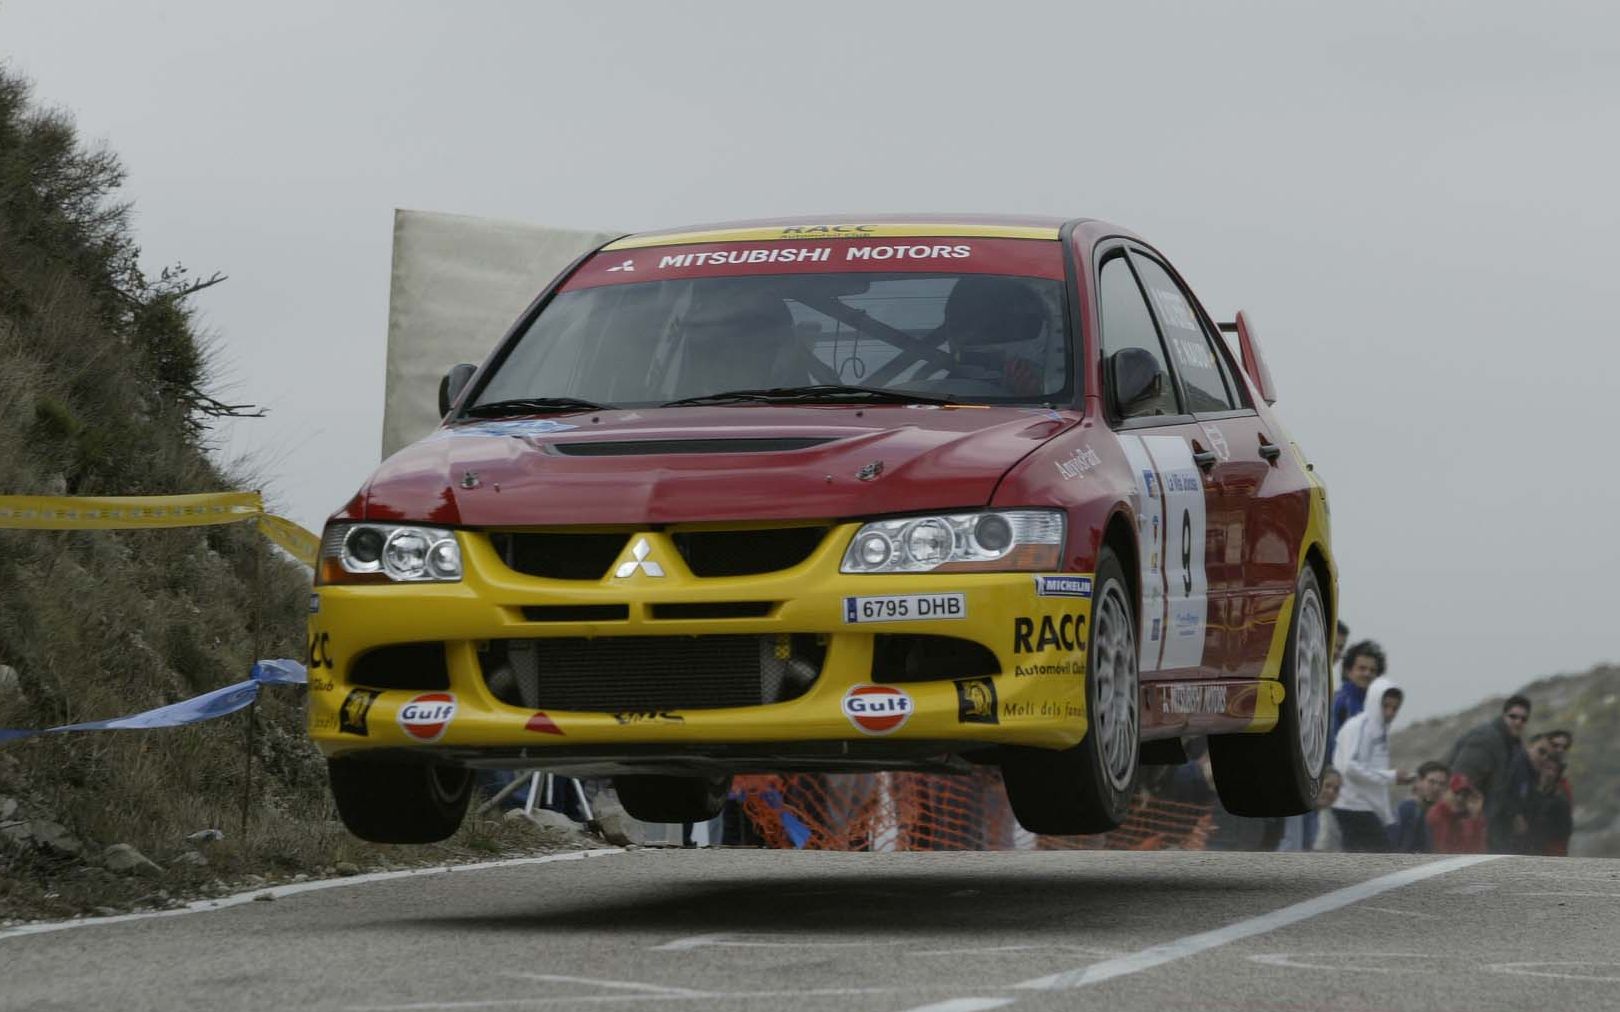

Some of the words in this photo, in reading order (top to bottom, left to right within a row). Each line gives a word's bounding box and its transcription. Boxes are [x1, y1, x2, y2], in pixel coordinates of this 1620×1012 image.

[782, 224, 879, 233] RACC
[658, 247, 830, 269] MITSUBISHI
[846, 244, 971, 260] MOTORS
[1181, 508, 1192, 598] 9
[1046, 580, 1091, 592] MICHELIN
[862, 599, 909, 618] 6795
[917, 597, 961, 616] DHB
[1013, 614, 1086, 654] RACC
[401, 704, 455, 721] Gulf
[846, 698, 909, 712] Gulf
